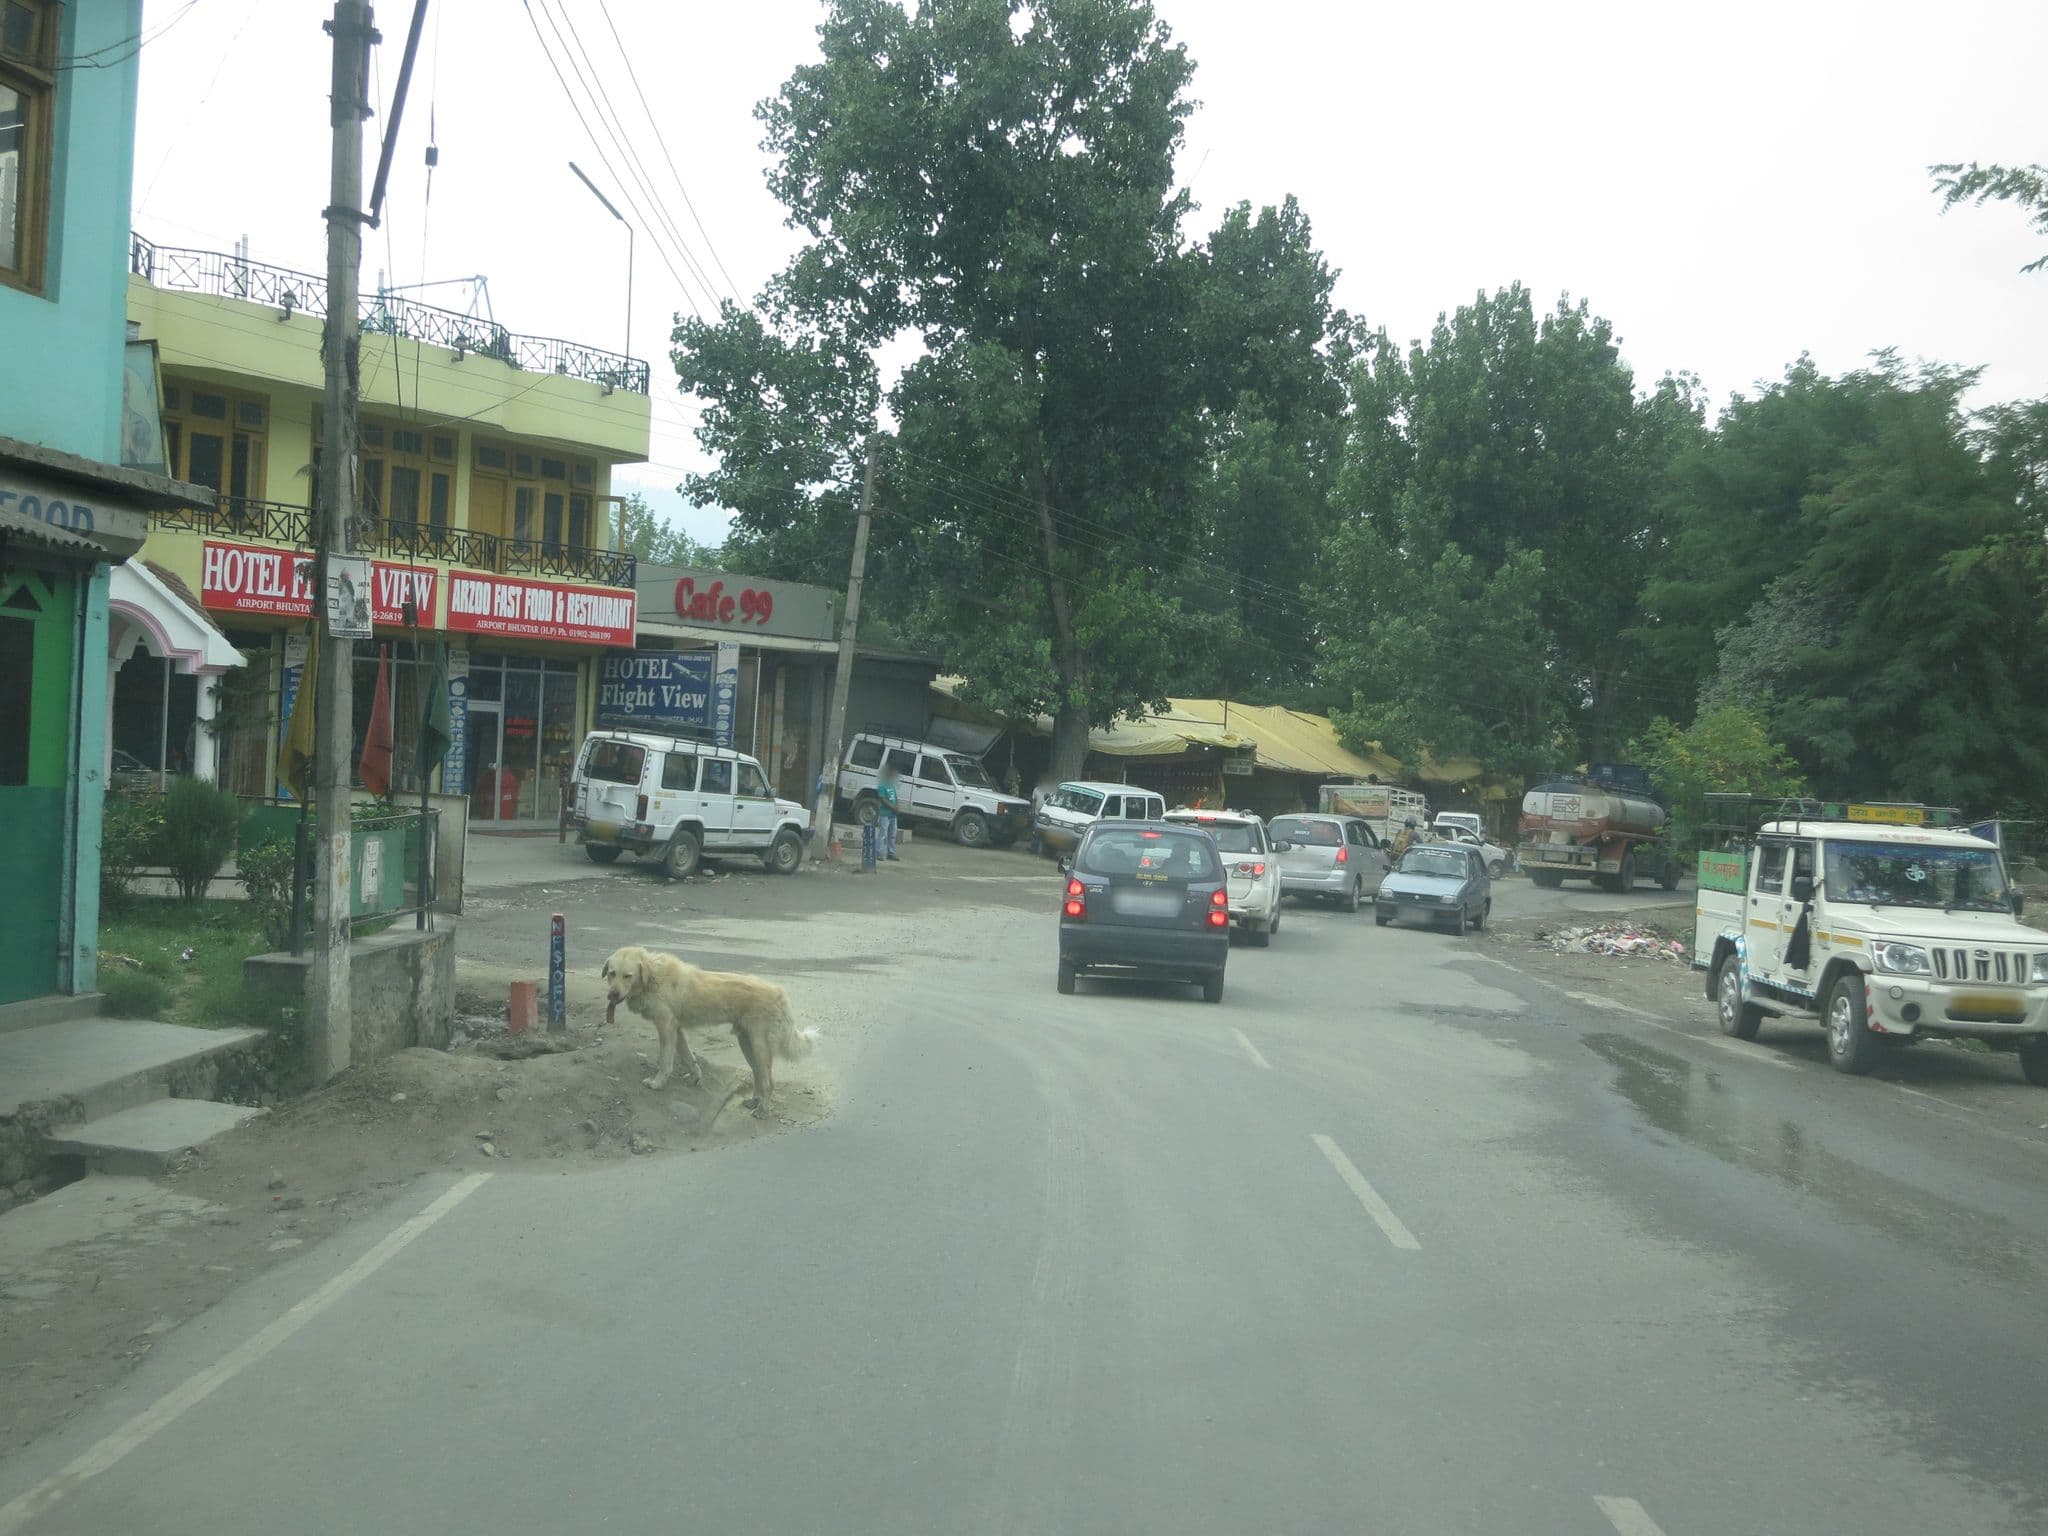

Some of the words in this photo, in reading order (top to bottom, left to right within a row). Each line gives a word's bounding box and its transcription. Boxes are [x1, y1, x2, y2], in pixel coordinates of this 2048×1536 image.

[203, 547, 286, 597] HOTEL
[379, 568, 434, 611] VIEW
[236, 598, 274, 610] AIRPORT
[276, 601, 313, 613] BHUNTA
[452, 578, 492, 615] ARZOO
[493, 583, 523, 619] FAST
[524, 587, 553, 622] FOOD
[556, 591, 564, 623] &
[566, 592, 632, 630] RESTAURANT
[675, 577, 736, 623] Cafe
[739, 588, 773, 625] 99
[476, 620, 506, 631] AIRPORT
[507, 623, 539, 634] BHUNTAR
[604, 657, 672, 680] HOTEL
[600, 683, 655, 713] Flight
[661, 684, 706, 709] View
